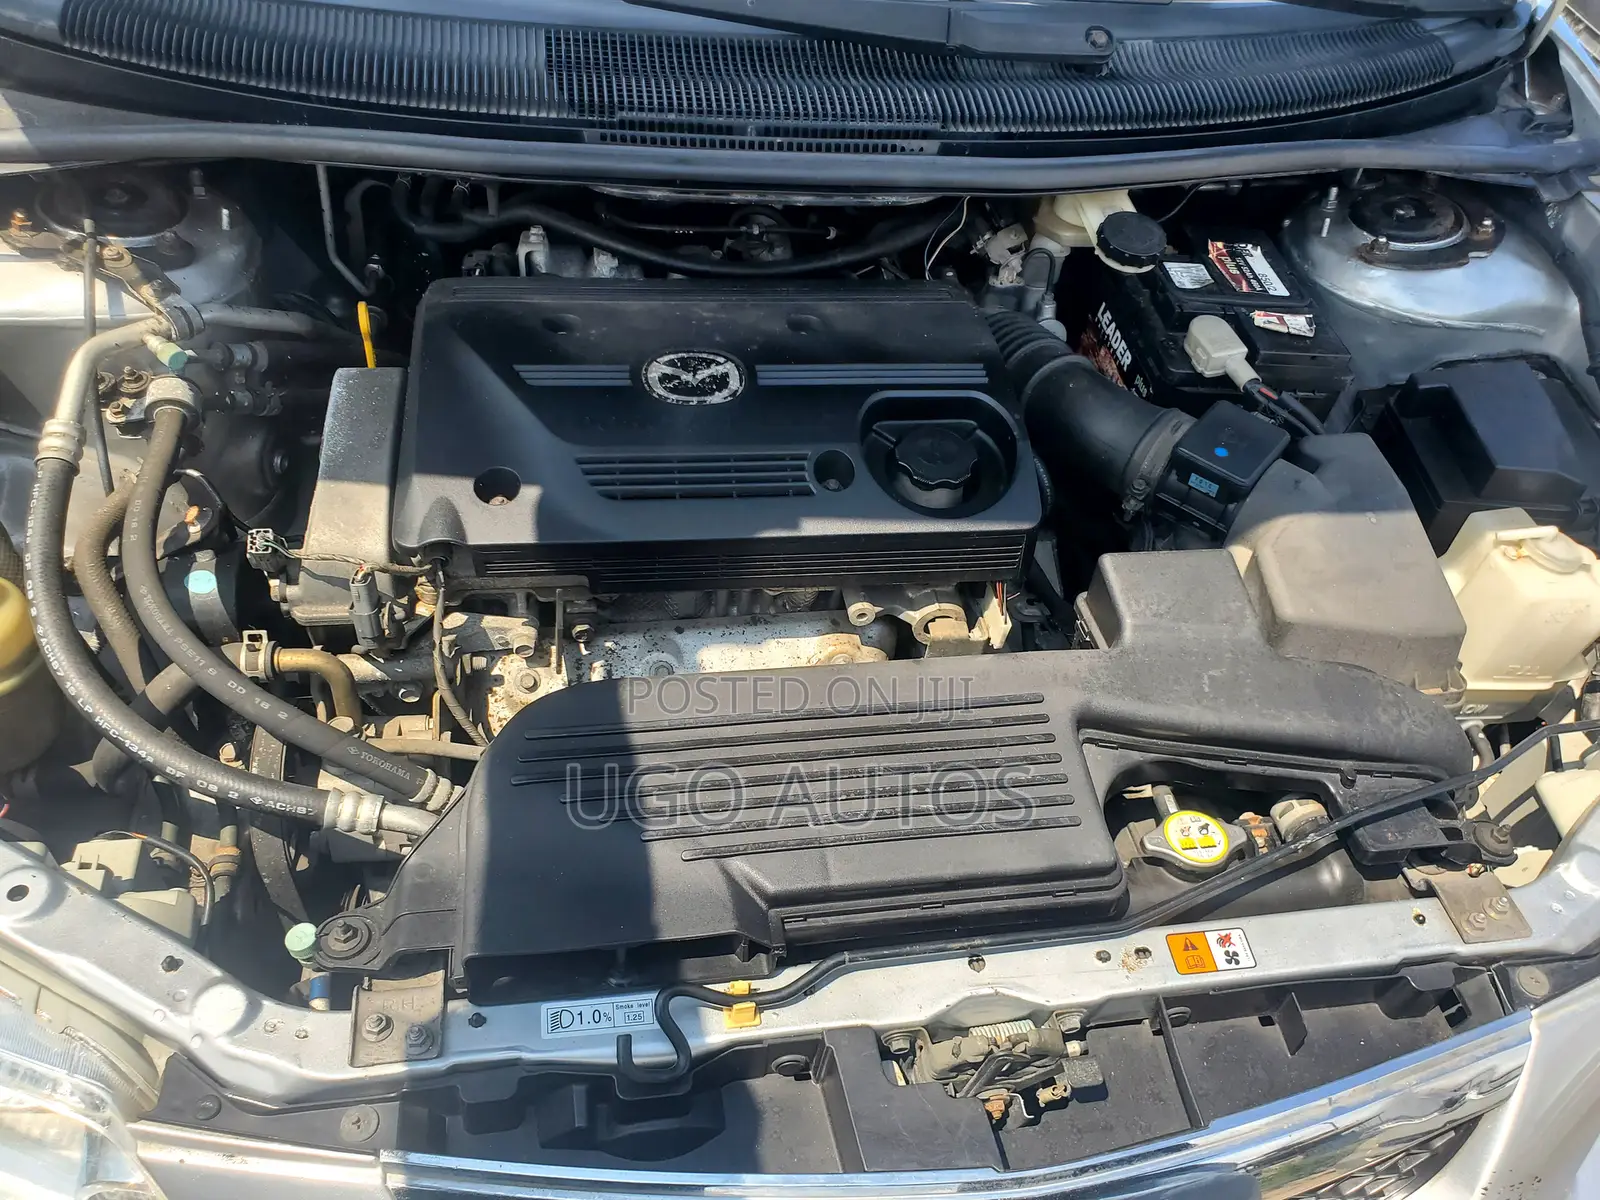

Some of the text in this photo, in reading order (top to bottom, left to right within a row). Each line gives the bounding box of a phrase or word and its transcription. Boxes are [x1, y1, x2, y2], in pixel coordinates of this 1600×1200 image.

[1218, 255, 1240, 275] plus
[1097, 301, 1132, 372] LEADER
[77, 698, 93, 713] LP
[95, 715, 155, 763] HFC-134a
[165, 766, 187, 778] DF
[227, 680, 247, 694] DD
[277, 711, 289, 720] 2
[360, 751, 411, 780] YOKOHAMA
[626, 1013, 643, 1021] 1.25
